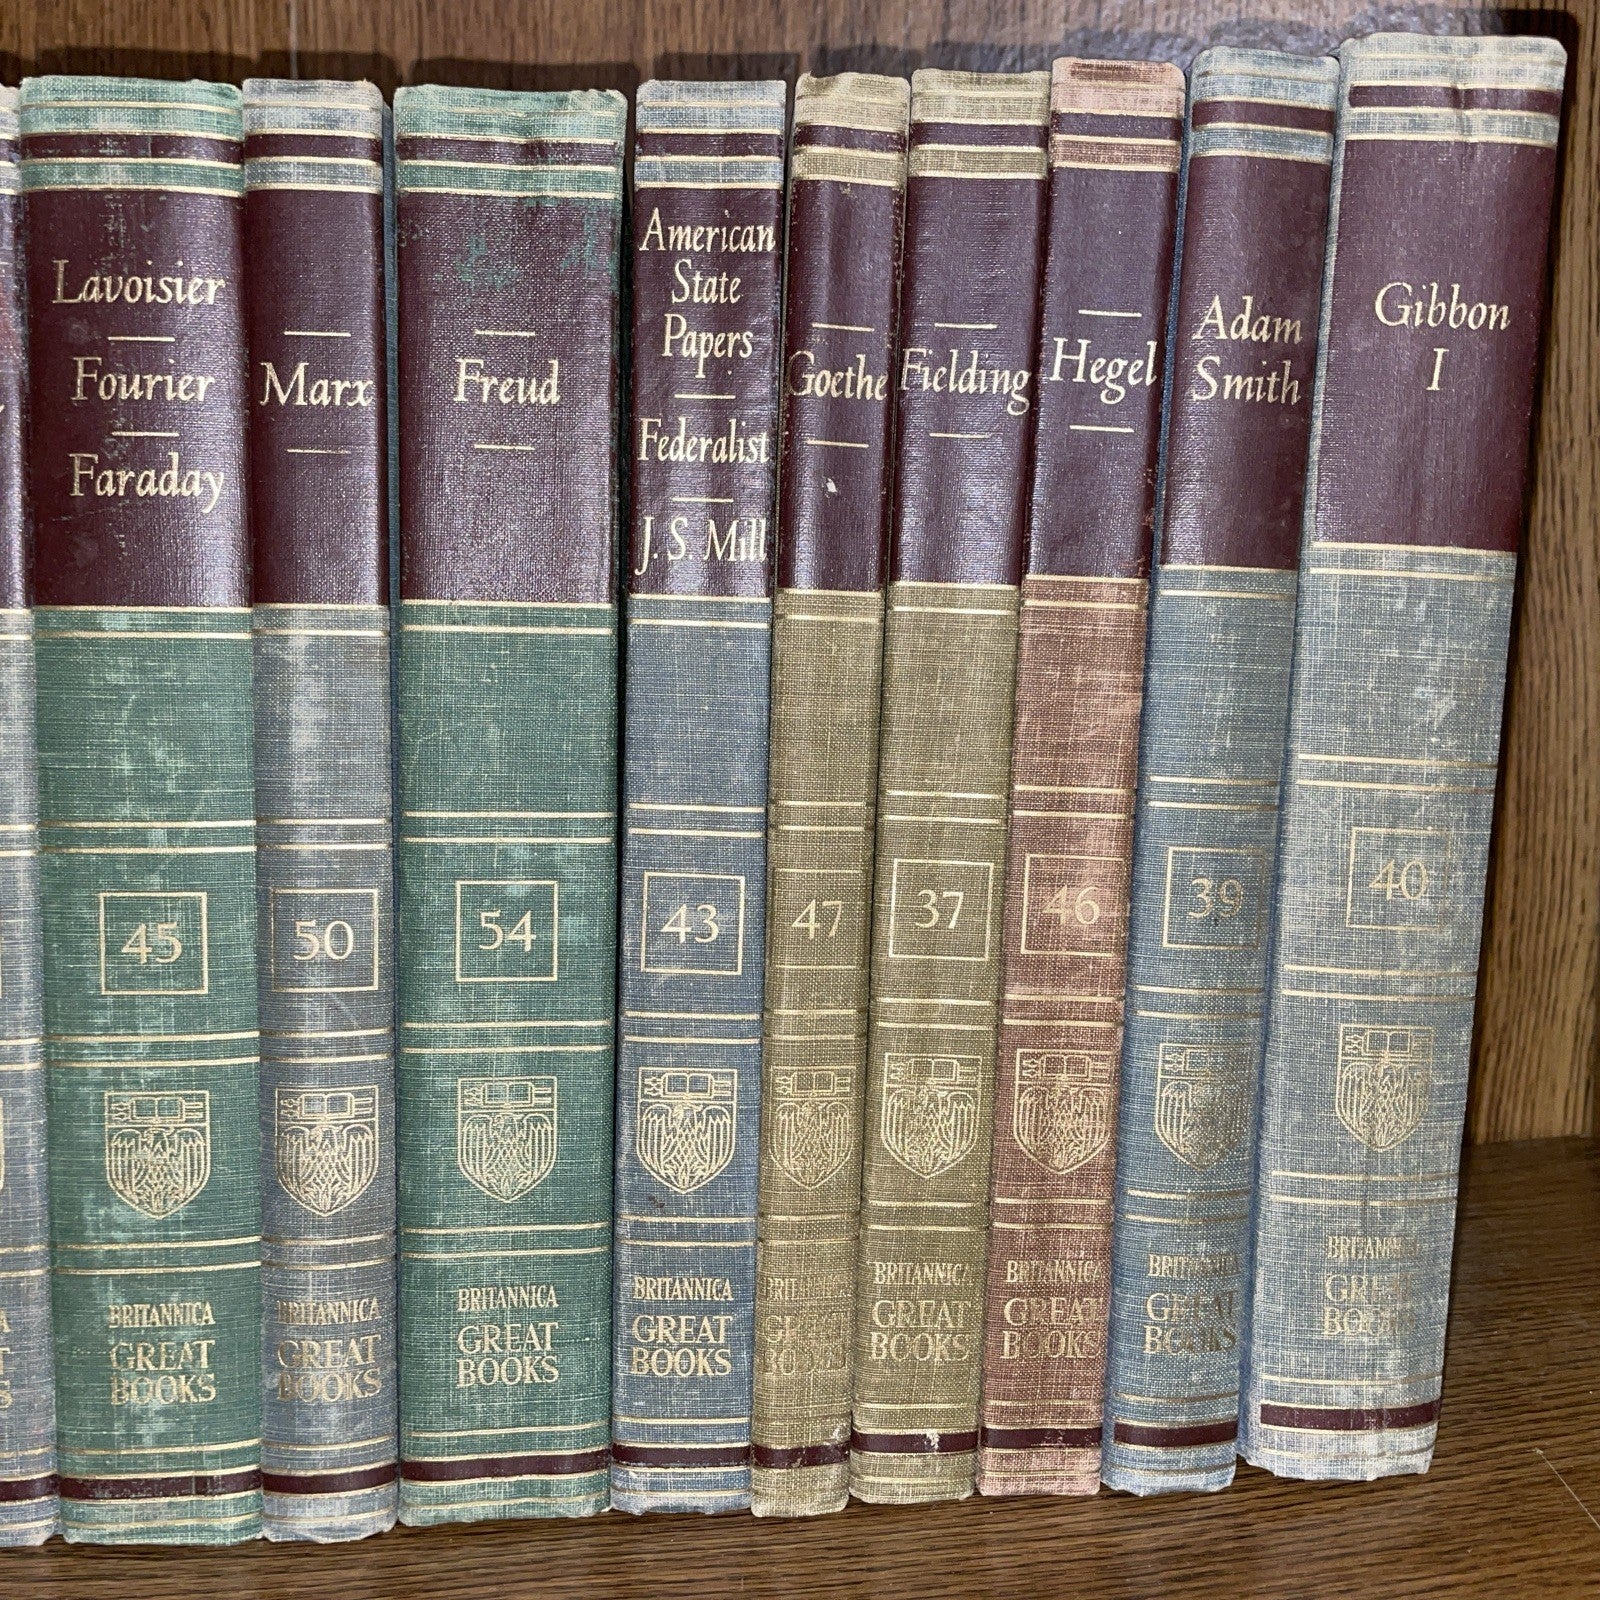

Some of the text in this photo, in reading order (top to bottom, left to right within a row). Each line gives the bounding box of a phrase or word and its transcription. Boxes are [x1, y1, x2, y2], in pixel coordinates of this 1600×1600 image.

[639, 207, 775, 253] American
[52, 260, 226, 304] Lavoisier
[672, 258, 742, 304] State
[1192, 295, 1303, 344] Adam
[1375, 281, 1511, 331] Gibbon
[662, 313, 754, 379] Papers
[72, 356, 216, 402] Fourier
[259, 361, 376, 407] Marx
[453, 357, 561, 405] Freud
[787, 350, 888, 401] Goethe
[900, 348, 1032, 416] Fielding
[1050, 337, 1158, 404] Hegel
[1192, 355, 1302, 406] Smith
[1426, 348, 1450, 391] I
[638, 416, 771, 465] Federalist
[69, 452, 225, 514] Faraday
[635, 516, 768, 576] J. S. Mill
[1189, 878, 1243, 918] 39
[1369, 858, 1429, 901] 40
[661, 903, 719, 944] 43
[791, 899, 843, 940] 47
[914, 889, 965, 930] 37
[1043, 885, 1100, 925] 46
[121, 921, 183, 965] 45
[293, 920, 355, 961] 50
[478, 909, 538, 953] 54
[456, 1285, 559, 1312] BRITANNICA
[633, 1277, 735, 1301] BRITANNICA
[108, 1301, 216, 1329] BRITANNICA
[277, 1296, 383, 1326] BRITANNICA
[632, 1314, 735, 1345] GREAT
[872, 1300, 972, 1328] GREAT
[1003, 1298, 1103, 1326] GREAT
[110, 1340, 216, 1371] GREAT
[277, 1335, 383, 1369] GREAT
[457, 1322, 559, 1355] GREAT
[870, 1331, 971, 1362] BOOKS
[1000, 1330, 1102, 1360] BOOKS
[456, 1355, 560, 1388] BOOKS
[631, 1347, 733, 1378] BOOKS
[110, 1372, 217, 1406] BOOKS
[277, 1368, 383, 1402] BOOKS
